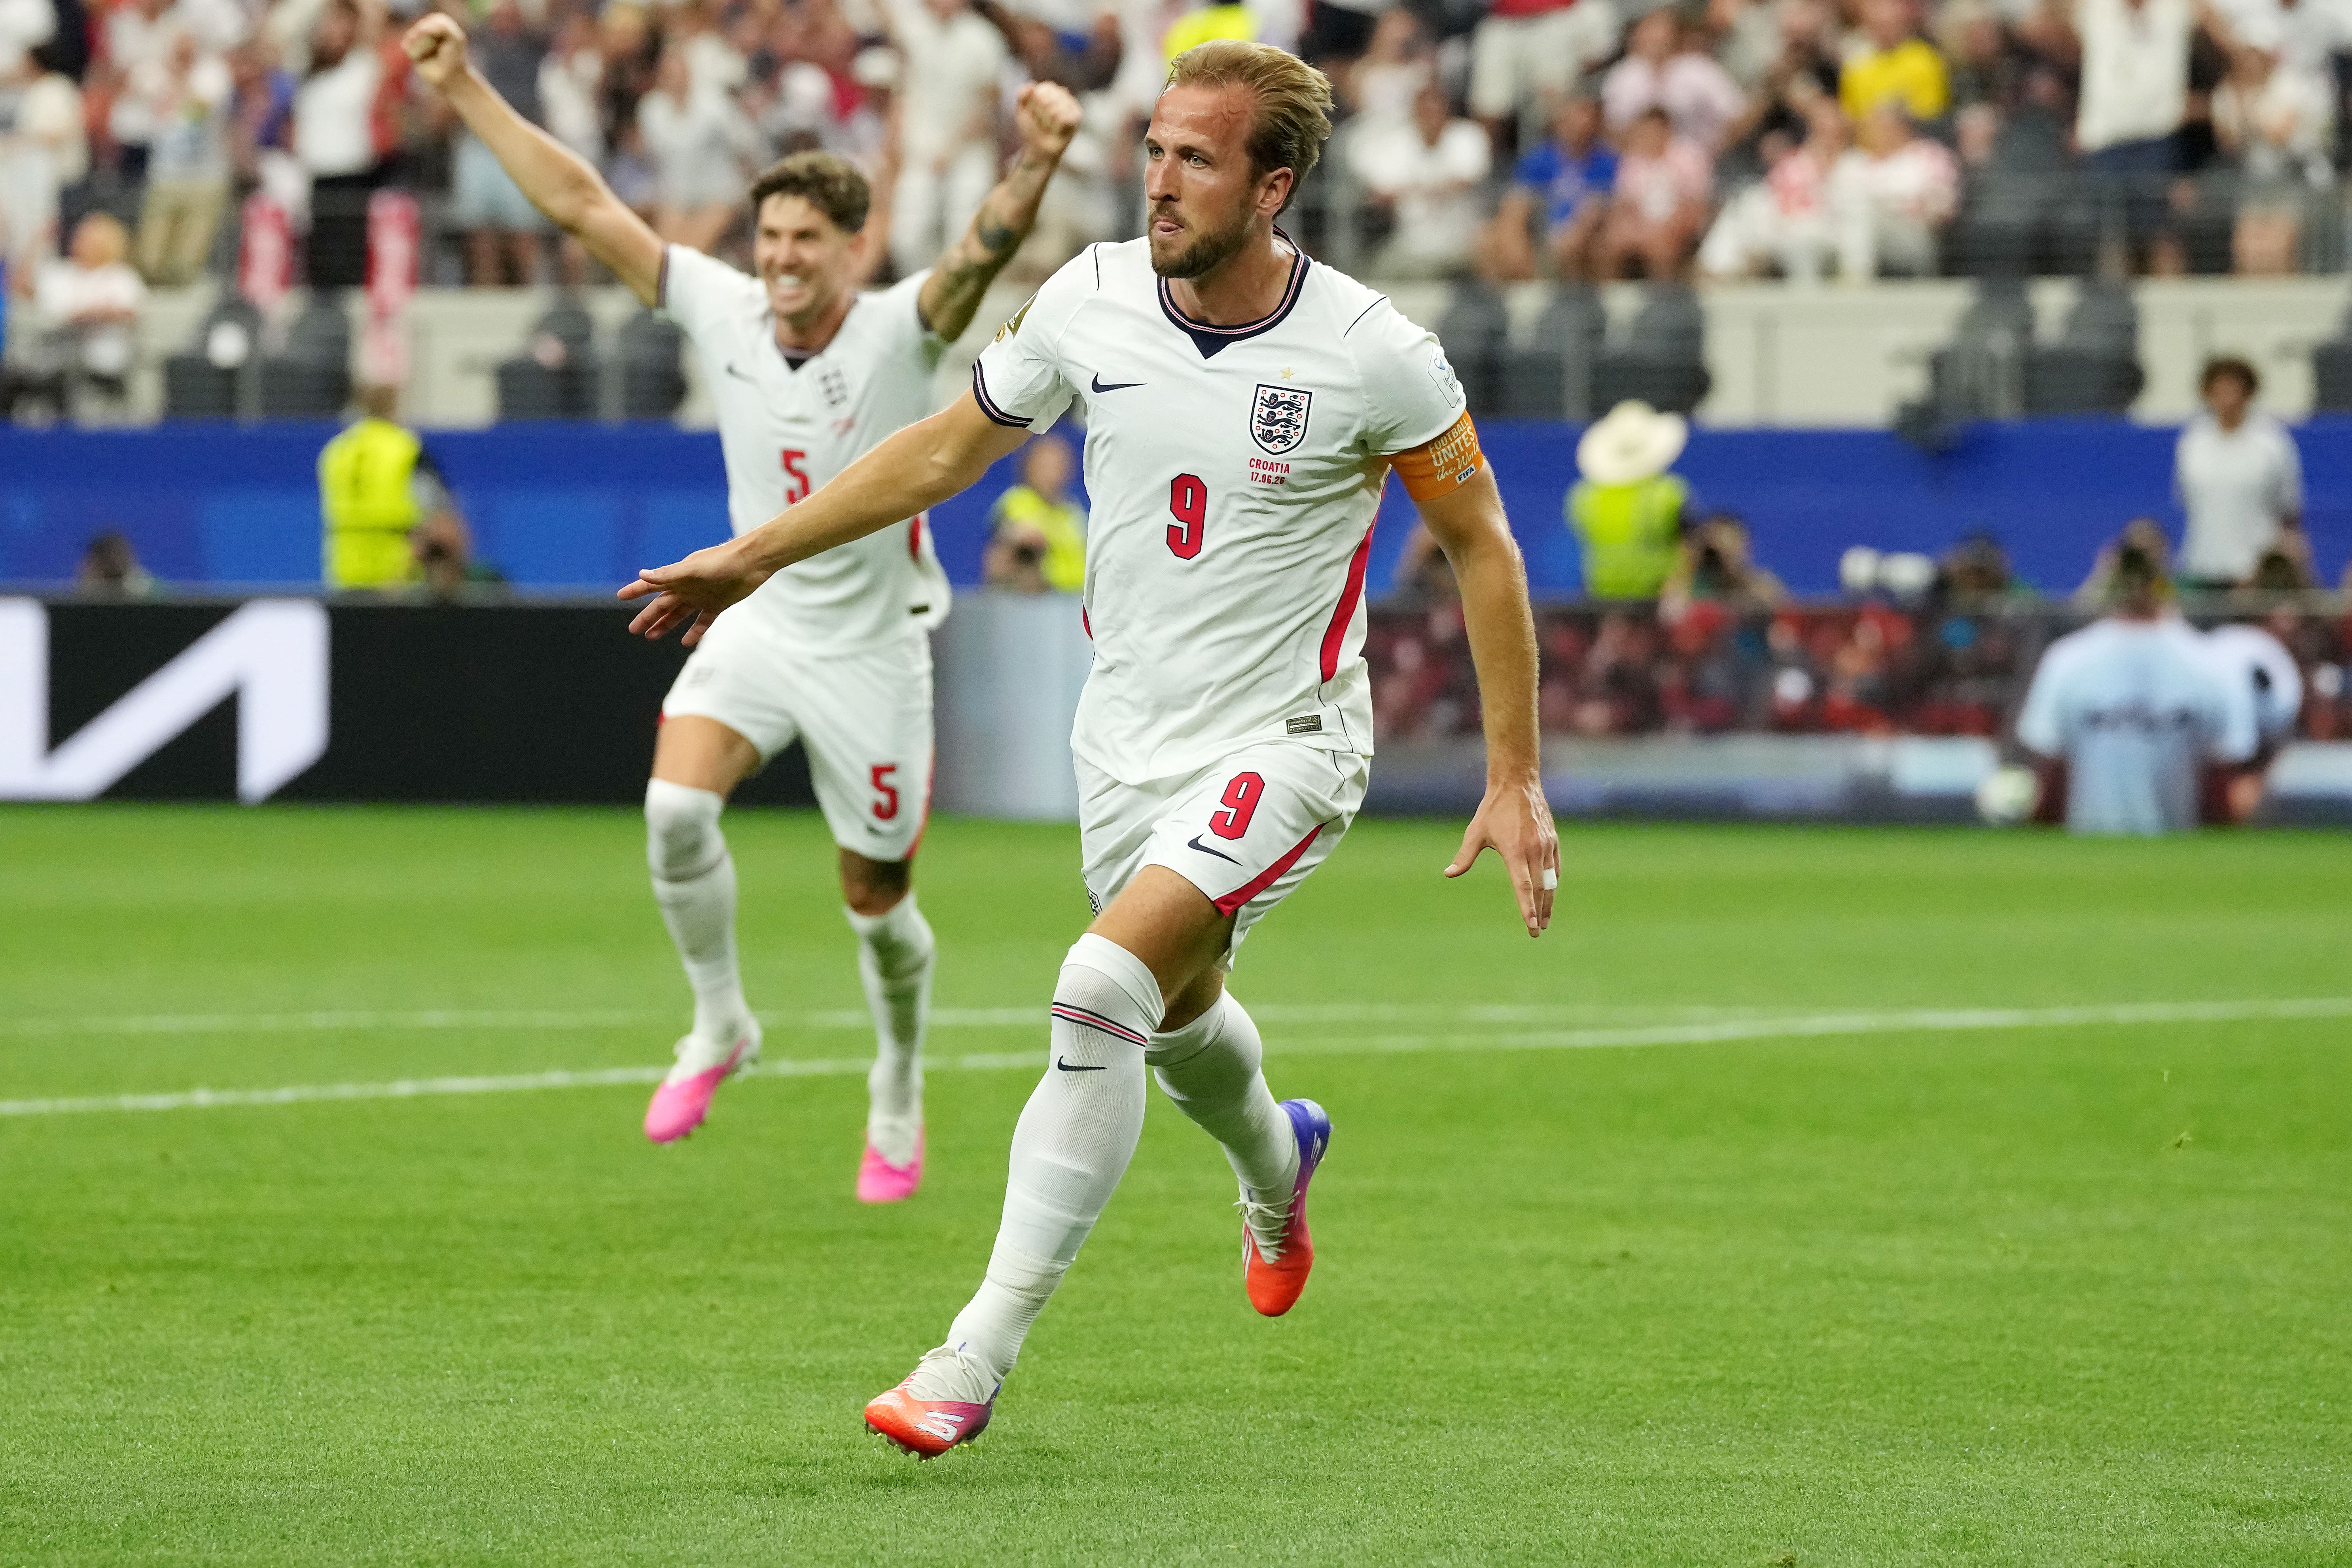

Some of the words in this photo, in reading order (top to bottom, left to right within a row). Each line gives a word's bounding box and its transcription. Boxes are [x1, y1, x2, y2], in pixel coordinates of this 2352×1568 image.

[1428, 417, 1469, 454] FOOTBALL
[1432, 426, 1474, 467] UNITES
[781, 449, 810, 504] 5
[1249, 458, 1290, 473] CROATIA
[1251, 472, 1285, 485] 17.06.26
[1436, 466, 1456, 481] the
[1458, 467, 1475, 482] FIFA
[1167, 473, 1207, 560] 9
[872, 766, 898, 820] 5
[1208, 772, 1265, 840] 9
